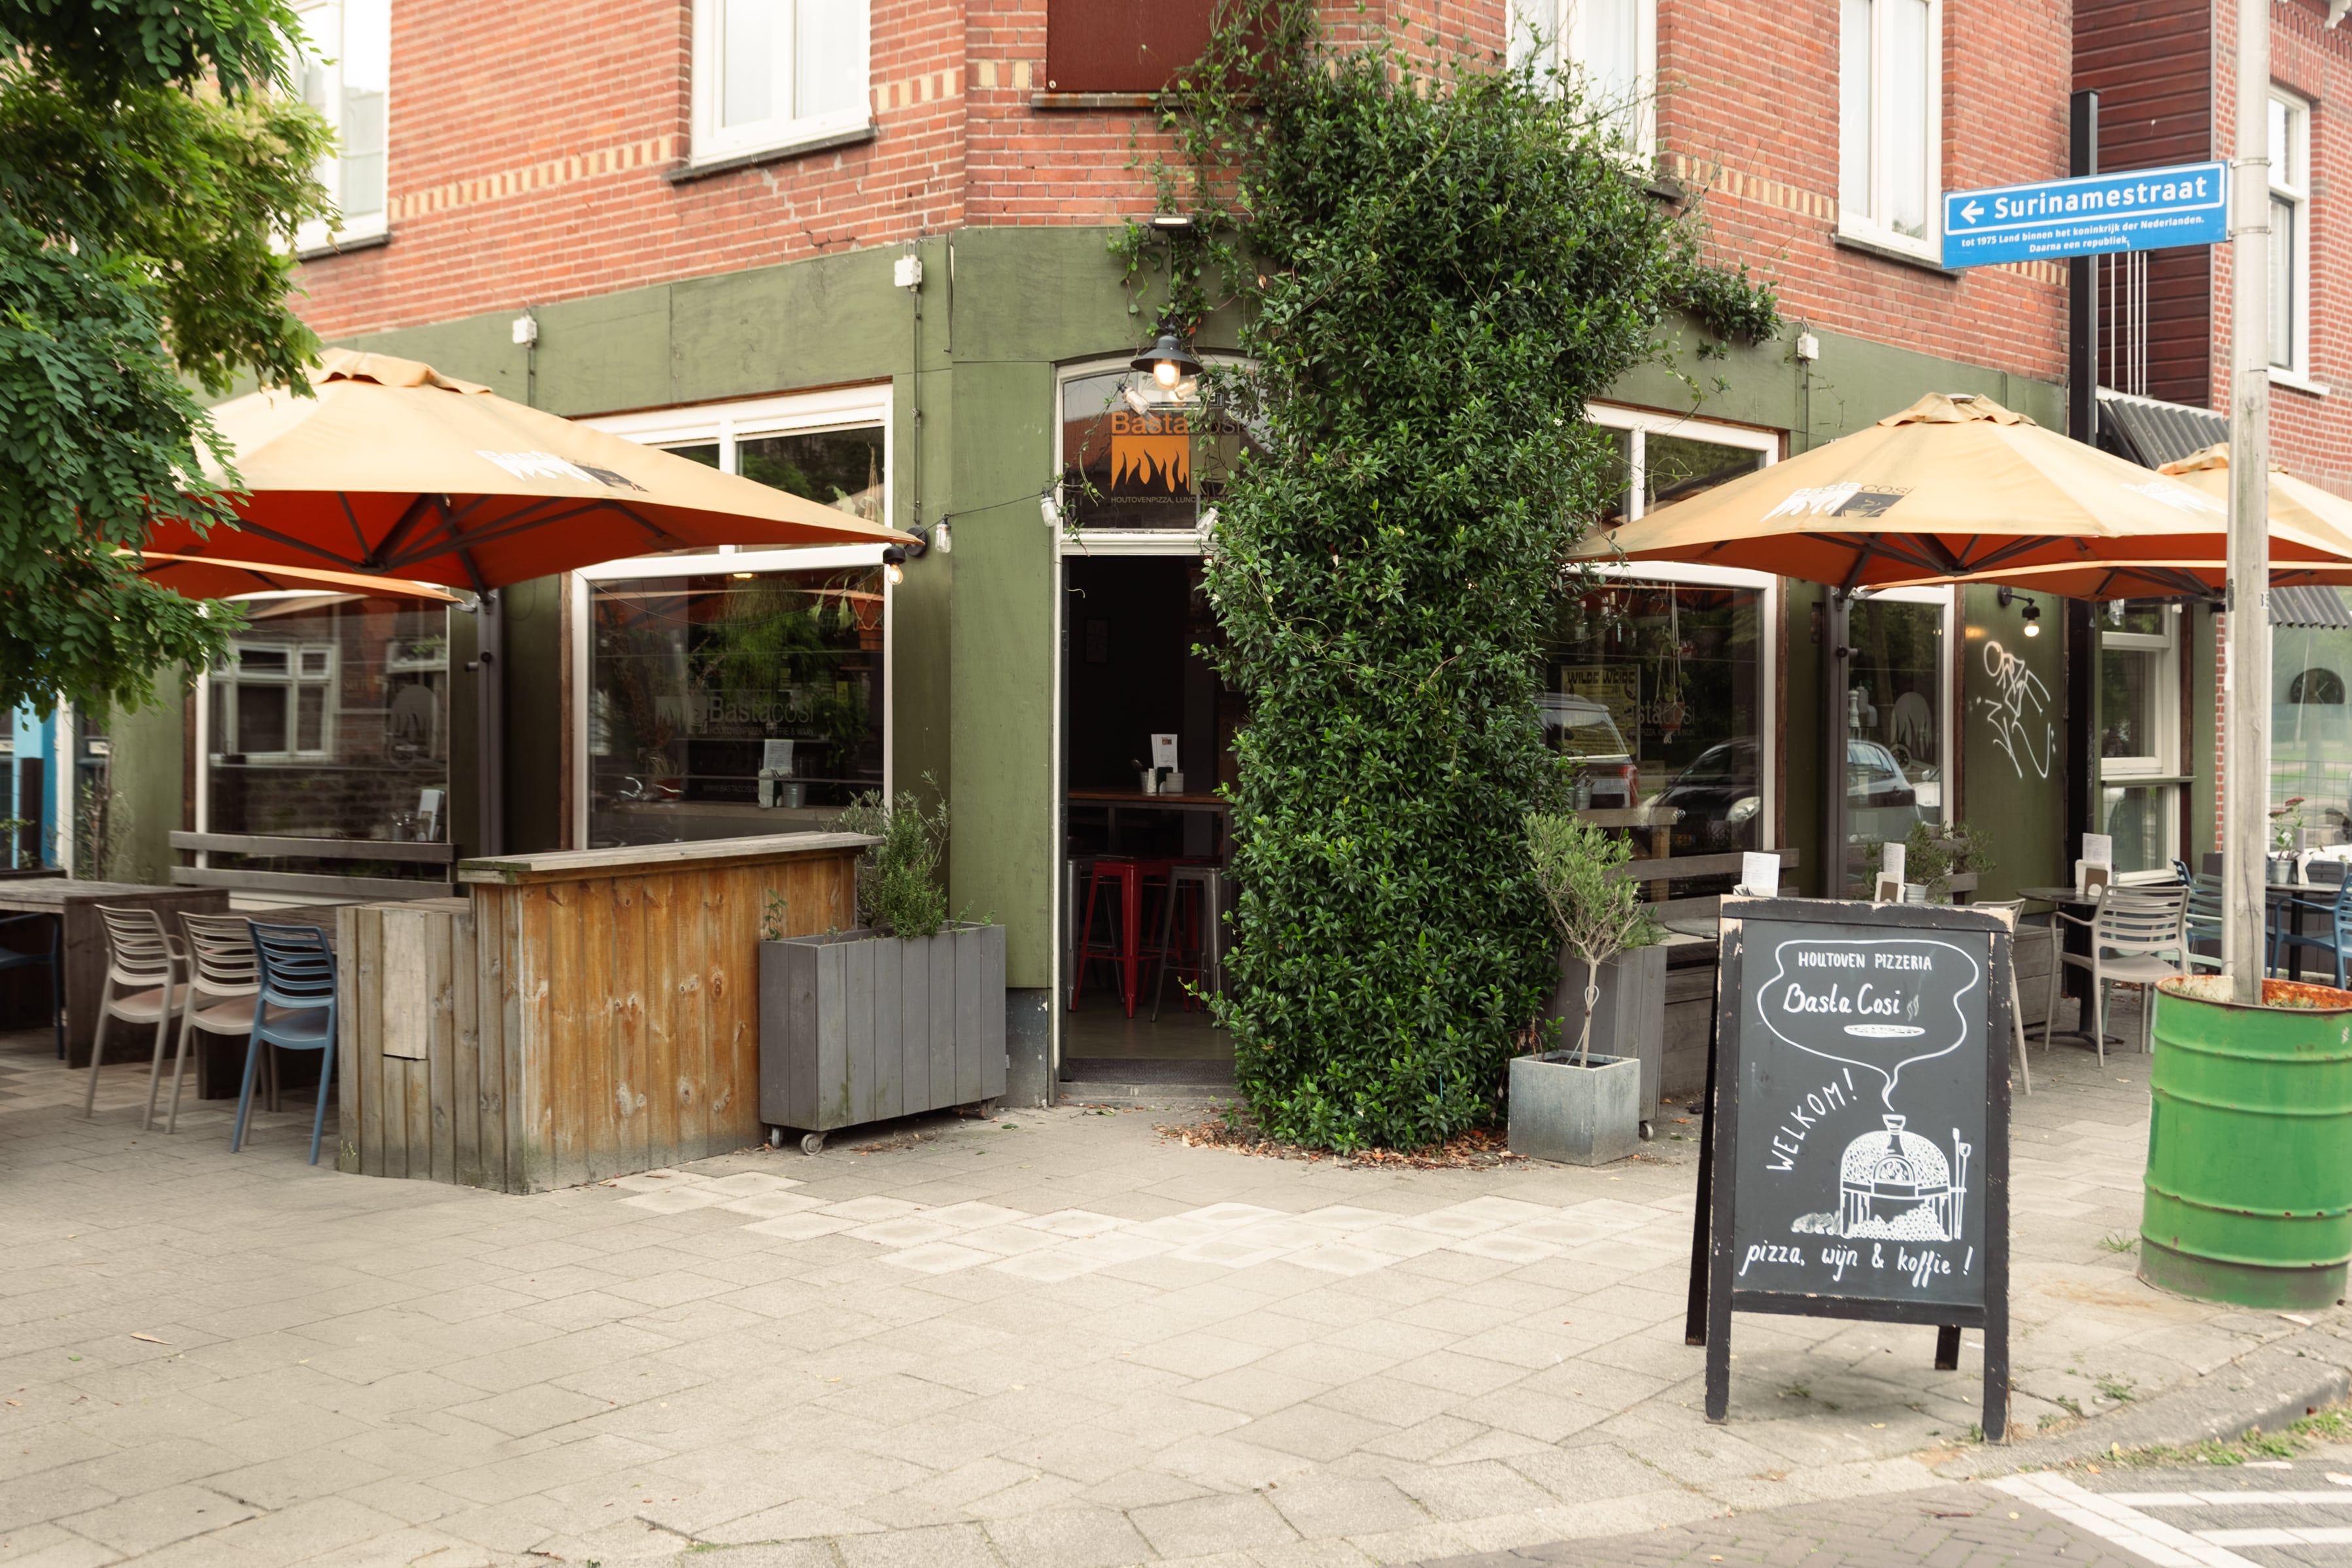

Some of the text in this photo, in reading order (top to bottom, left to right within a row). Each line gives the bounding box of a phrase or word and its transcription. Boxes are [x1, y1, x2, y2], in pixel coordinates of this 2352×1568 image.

[1994, 177, 2207, 219] Surinamestraat
[1962, 216, 2204, 247] tot 1975 Land binnen het koninkrijk der Nederlanden.
[2029, 243, 2060, 253] Daarna
[2064, 241, 2080, 249] een
[1567, 670, 1635, 684] WILDE WEIDE
[1798, 951, 1933, 971] HOUTOVEN PIZZERIA
[1782, 982, 1852, 1014] Basta
[1765, 1067, 1858, 1171] WELKOM!
[1738, 1239, 1805, 1277] pizza,
[1821, 1244, 1858, 1282] wijn
[1871, 1242, 1884, 1269] &
[1897, 1246, 1951, 1288] koffie
